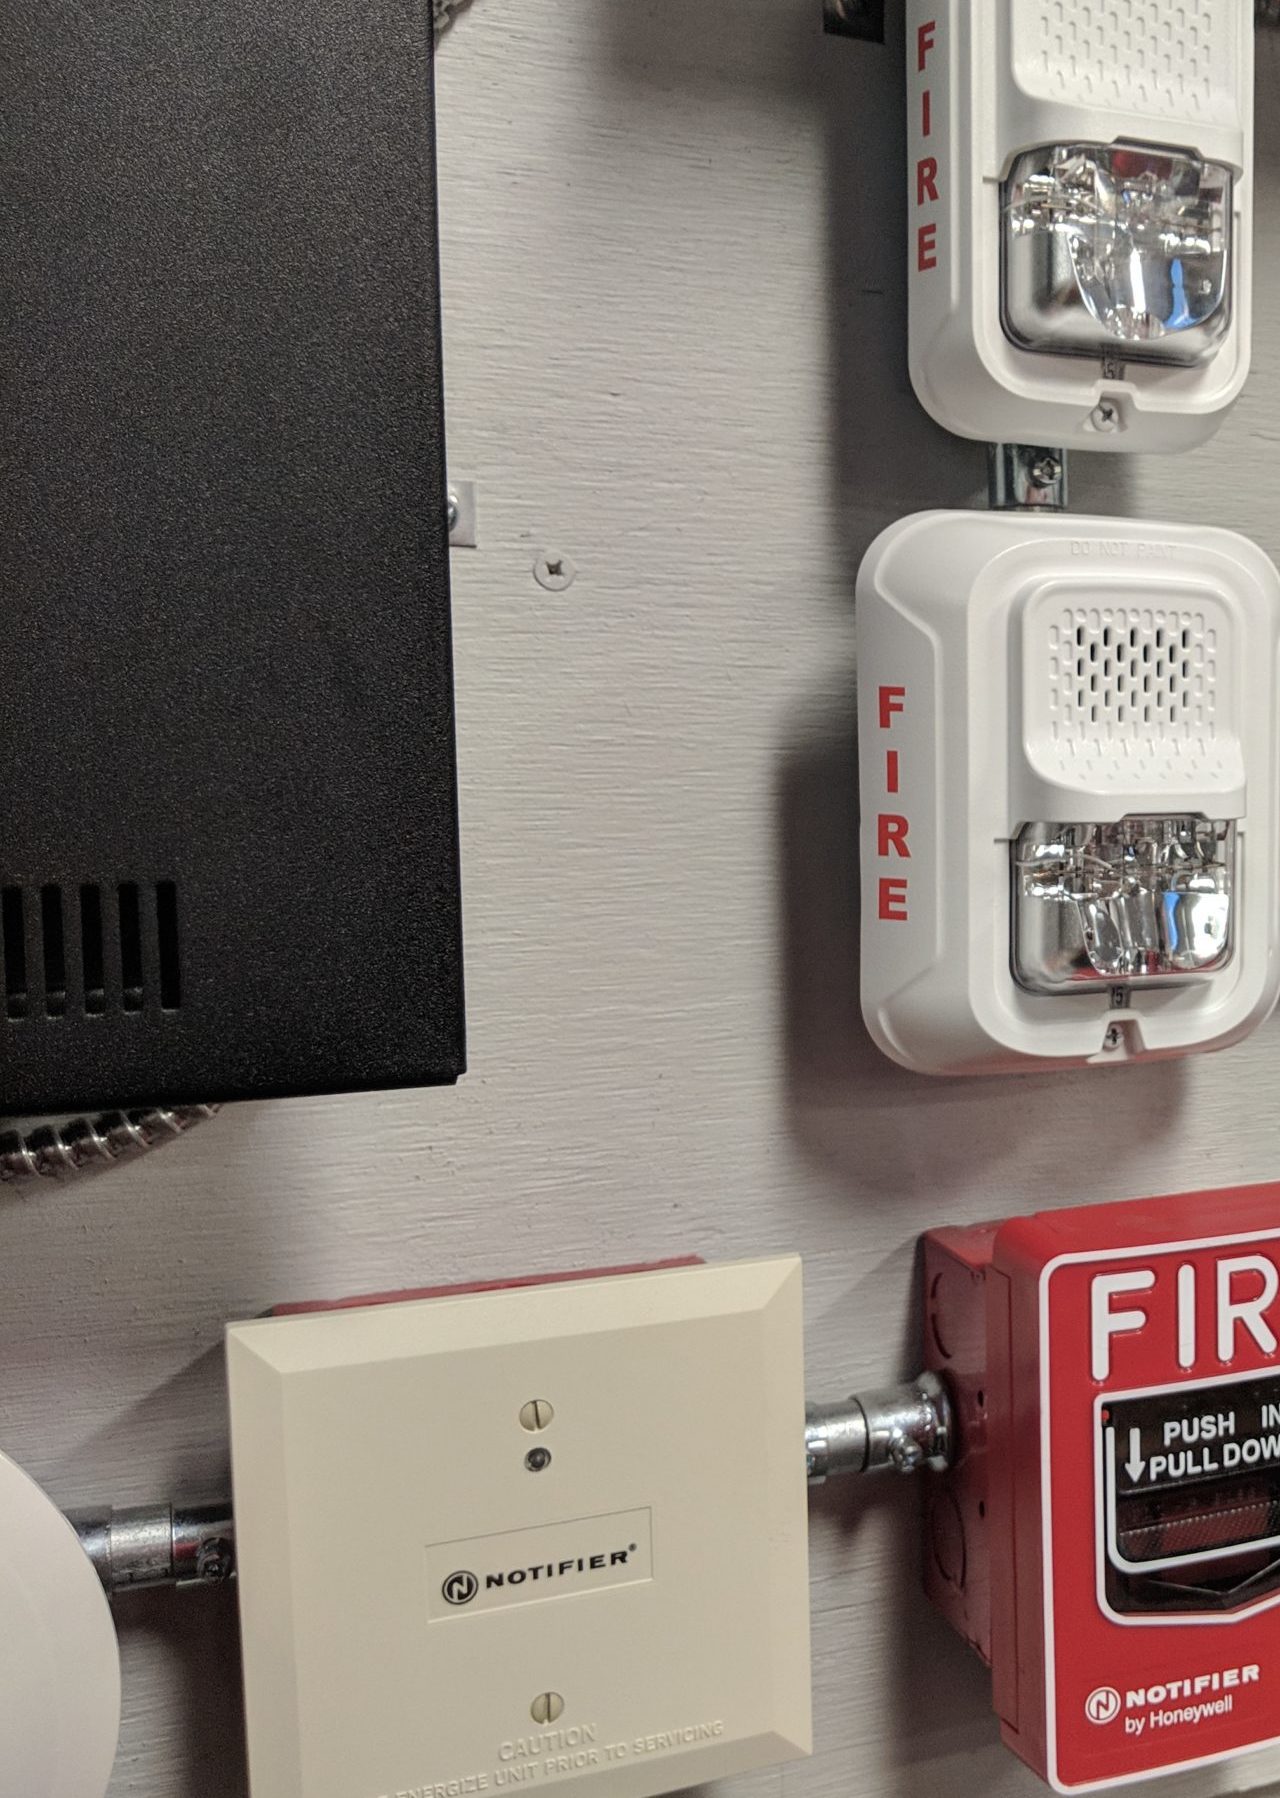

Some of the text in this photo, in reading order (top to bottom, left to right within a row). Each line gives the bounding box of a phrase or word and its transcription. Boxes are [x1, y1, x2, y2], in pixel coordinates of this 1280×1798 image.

[917, 21, 939, 272] FIRE
[877, 685, 912, 921] FIRE
[1163, 1411, 1236, 1447] PUSH
[1150, 1448, 1219, 1482] PULL
[485, 1550, 629, 1590] NOTIFIER
[1125, 1664, 1260, 1709] NOTIFIER
[1125, 1694, 1233, 1736] by Honeywell
[494, 1761, 539, 1787] UNIT
[543, 1749, 600, 1776] PRIOR
[604, 1743, 628, 1761] TO
[632, 1719, 725, 1754] SERVICING
[498, 1722, 597, 1762] CAUTION
